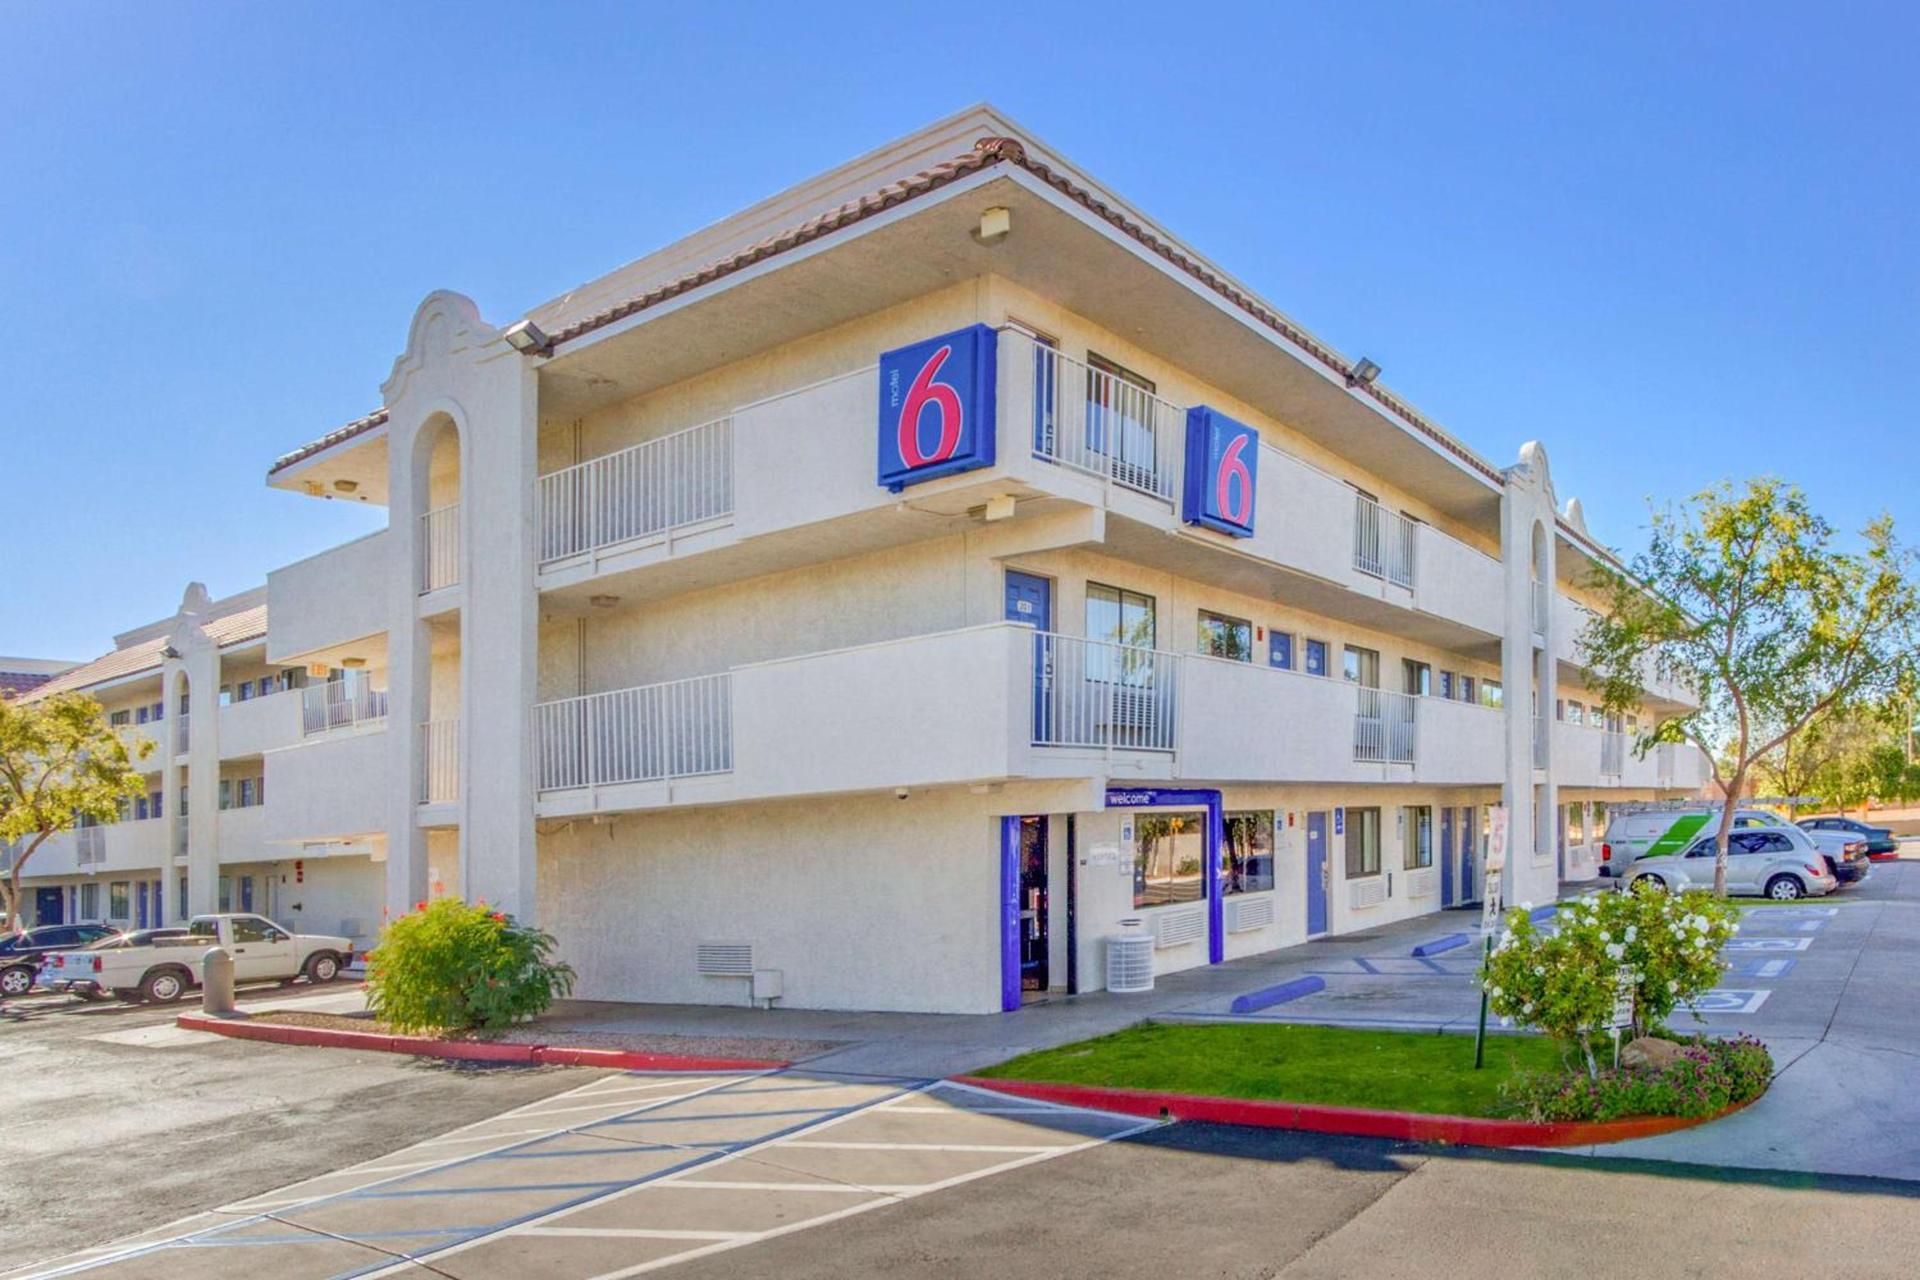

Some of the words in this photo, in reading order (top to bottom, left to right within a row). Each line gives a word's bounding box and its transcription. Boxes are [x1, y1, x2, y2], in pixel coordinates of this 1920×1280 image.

[889, 369, 900, 408] motel
[897, 344, 963, 469] 6
[1216, 433, 1253, 527] 6
[1110, 791, 1150, 805] welcome
